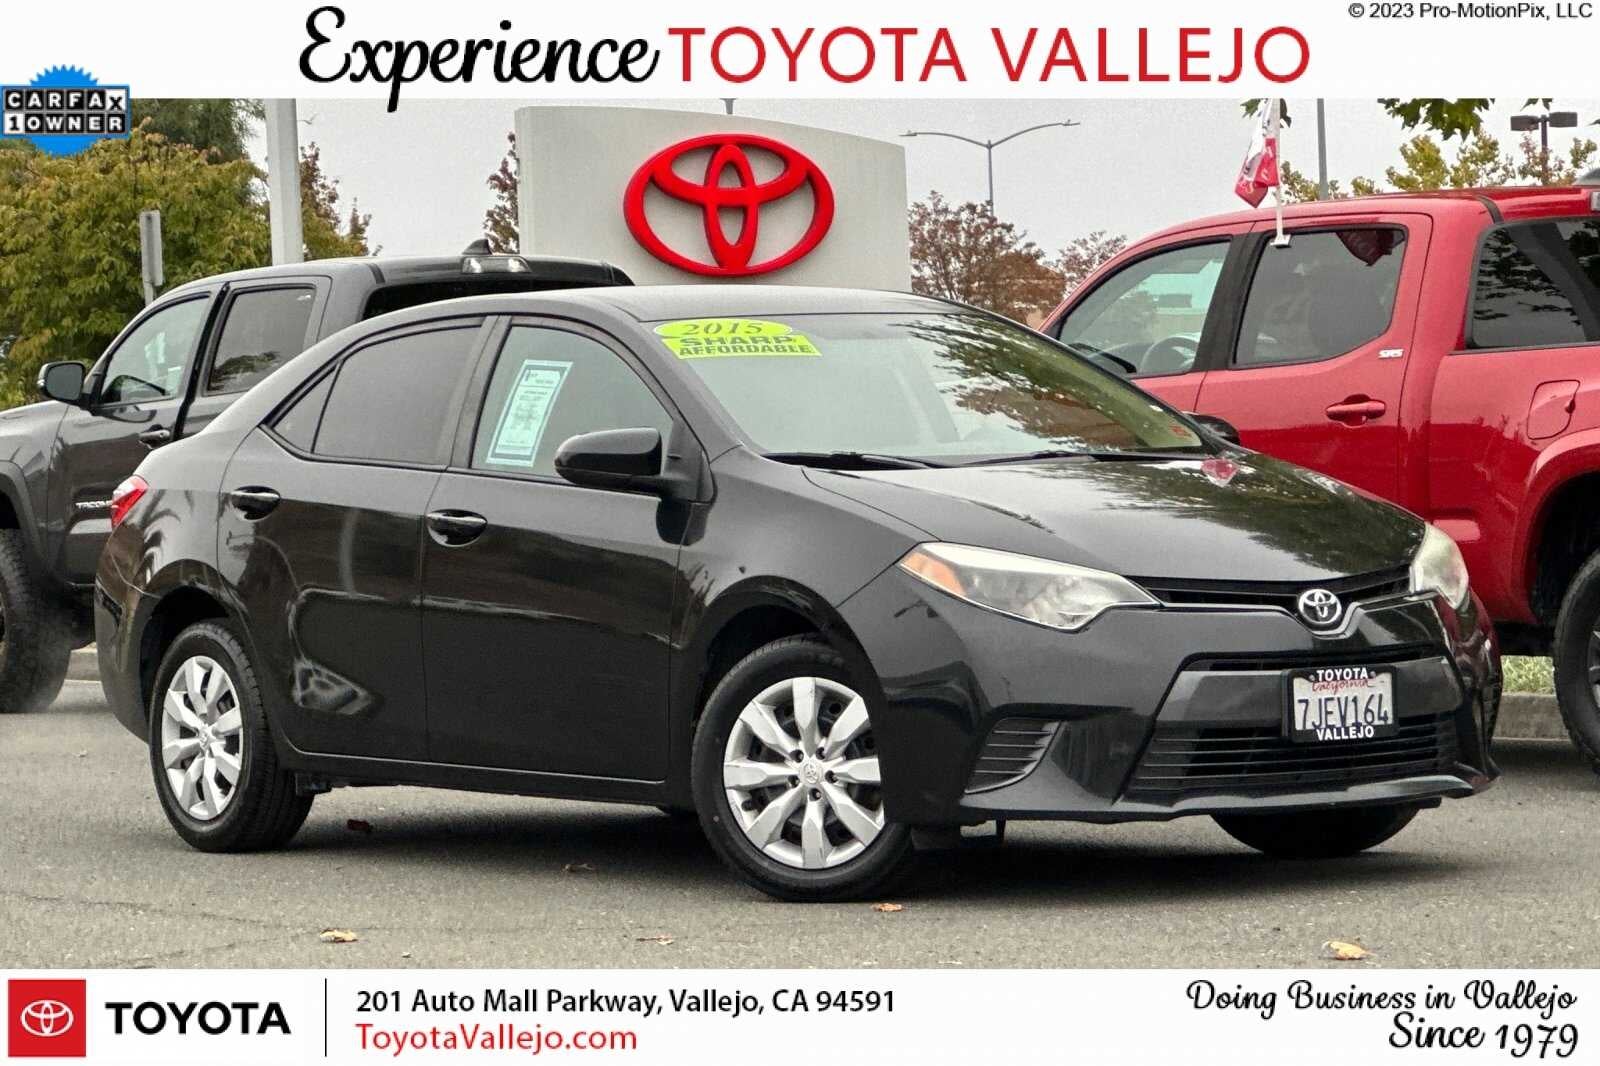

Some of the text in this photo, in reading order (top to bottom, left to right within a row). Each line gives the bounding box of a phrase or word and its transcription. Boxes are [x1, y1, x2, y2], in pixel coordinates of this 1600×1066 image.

[681, 322, 763, 336] 2015
[679, 336, 793, 346] SHARP
[679, 344, 814, 356] AFFORDABLE
[75, 500, 113, 509] TACOM
[1316, 667, 1369, 681] TOYOTA
[1312, 679, 1369, 696] California
[1297, 693, 1388, 731] 7JEV164
[1316, 725, 1375, 741] VALLEJO
